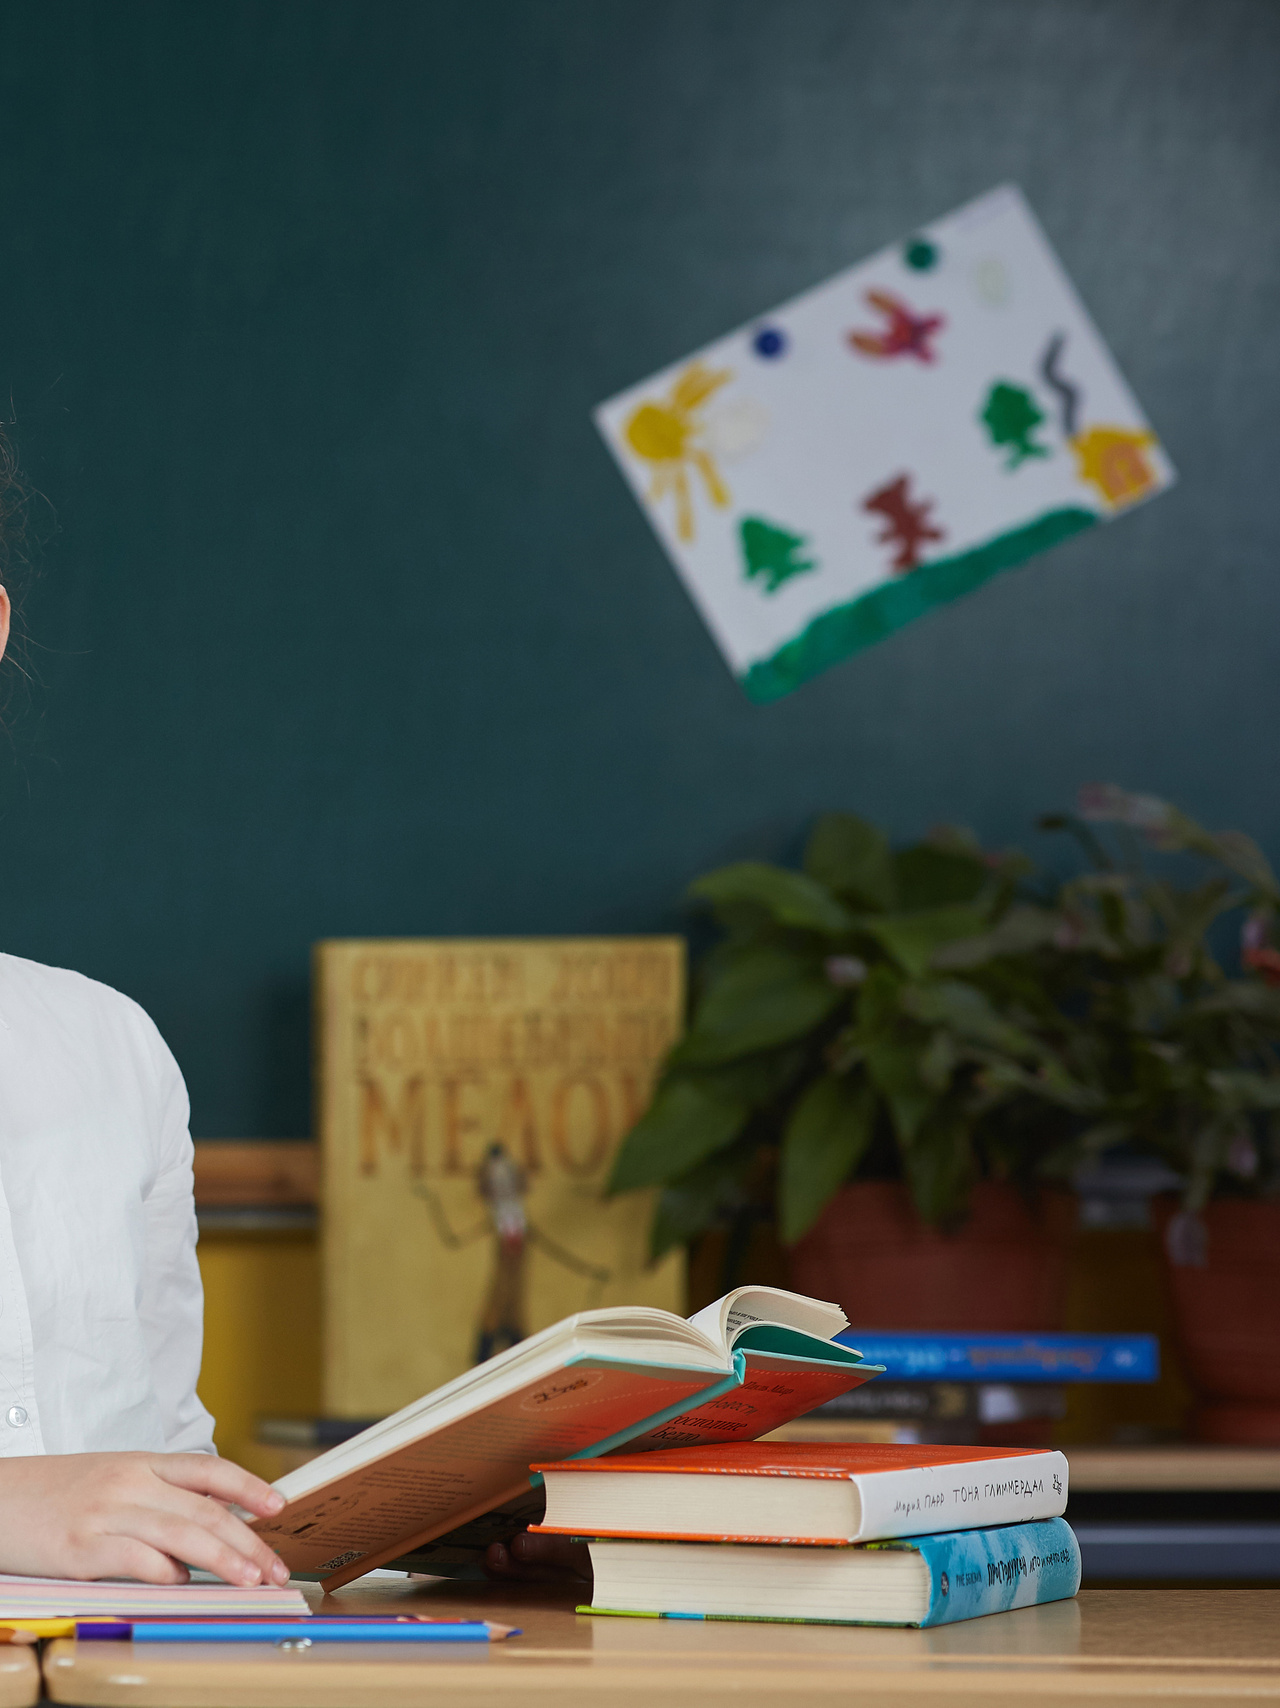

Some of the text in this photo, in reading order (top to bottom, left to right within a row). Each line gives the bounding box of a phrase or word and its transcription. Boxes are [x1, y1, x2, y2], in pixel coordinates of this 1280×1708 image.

[697, 1396, 758, 1416] Новости
[651, 1426, 701, 1442] Белло
[894, 1498, 921, 1517] Мария
[925, 1492, 945, 1508] ПАРР
[953, 1486, 980, 1503] ТОНЯ
[984, 1479, 1045, 1499] ГЛИММЕРДАЛ
